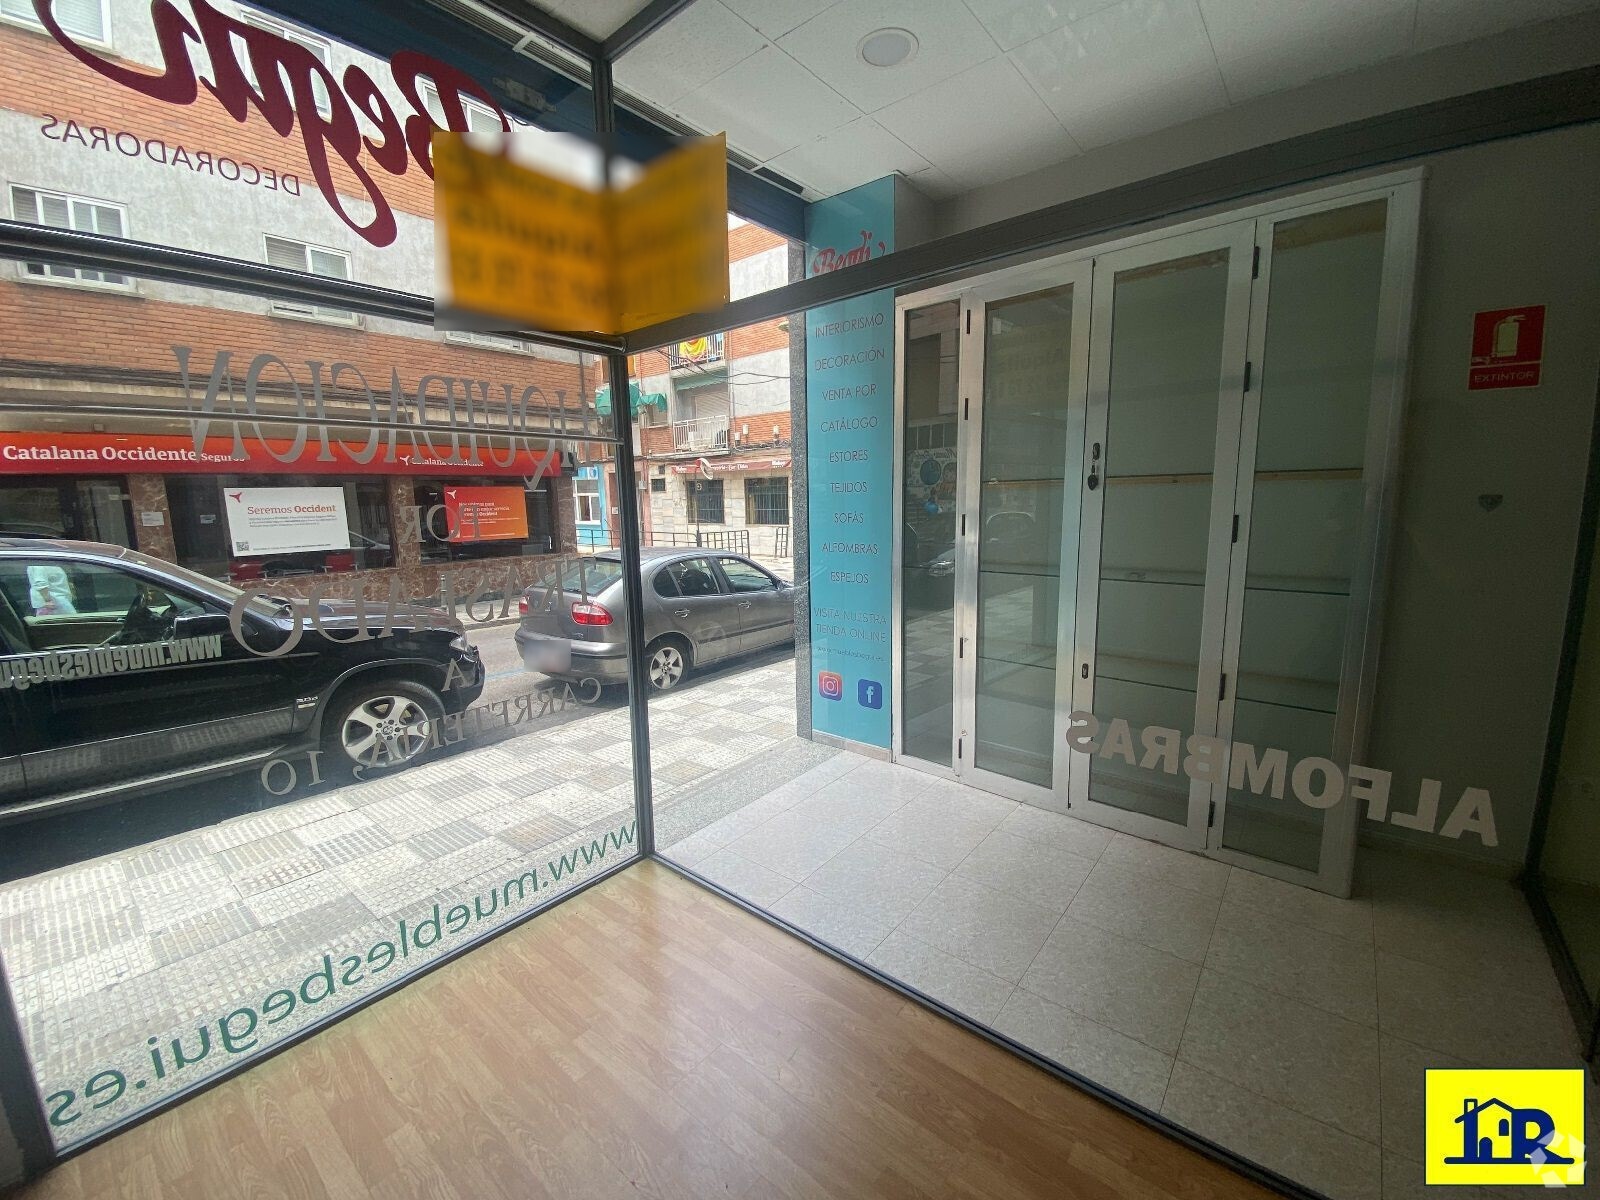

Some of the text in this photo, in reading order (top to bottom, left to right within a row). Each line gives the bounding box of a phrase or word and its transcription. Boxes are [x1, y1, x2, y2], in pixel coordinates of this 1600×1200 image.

[815, 312, 884, 339] INTERIORISMO
[815, 346, 885, 371] DECORACIÓN
[1474, 370, 1535, 384] EXTINTOR
[822, 383, 877, 401] VENTA POR
[820, 416, 878, 433] CATÁLOGO
[3, 445, 99, 461] Catalana
[102, 446, 197, 462] Occidente
[829, 449, 869, 463] ESTORES
[830, 481, 868, 493] TEJIDOS
[247, 504, 337, 515] Seremos Occident
[834, 510, 864, 524] SOFÁS
[822, 542, 878, 555] ALFOMBRAS
[830, 571, 869, 584] ESPEJOS
[813, 607, 887, 625] VISITA NUESTRA
[816, 623, 886, 643] TIENDA ONLINE
